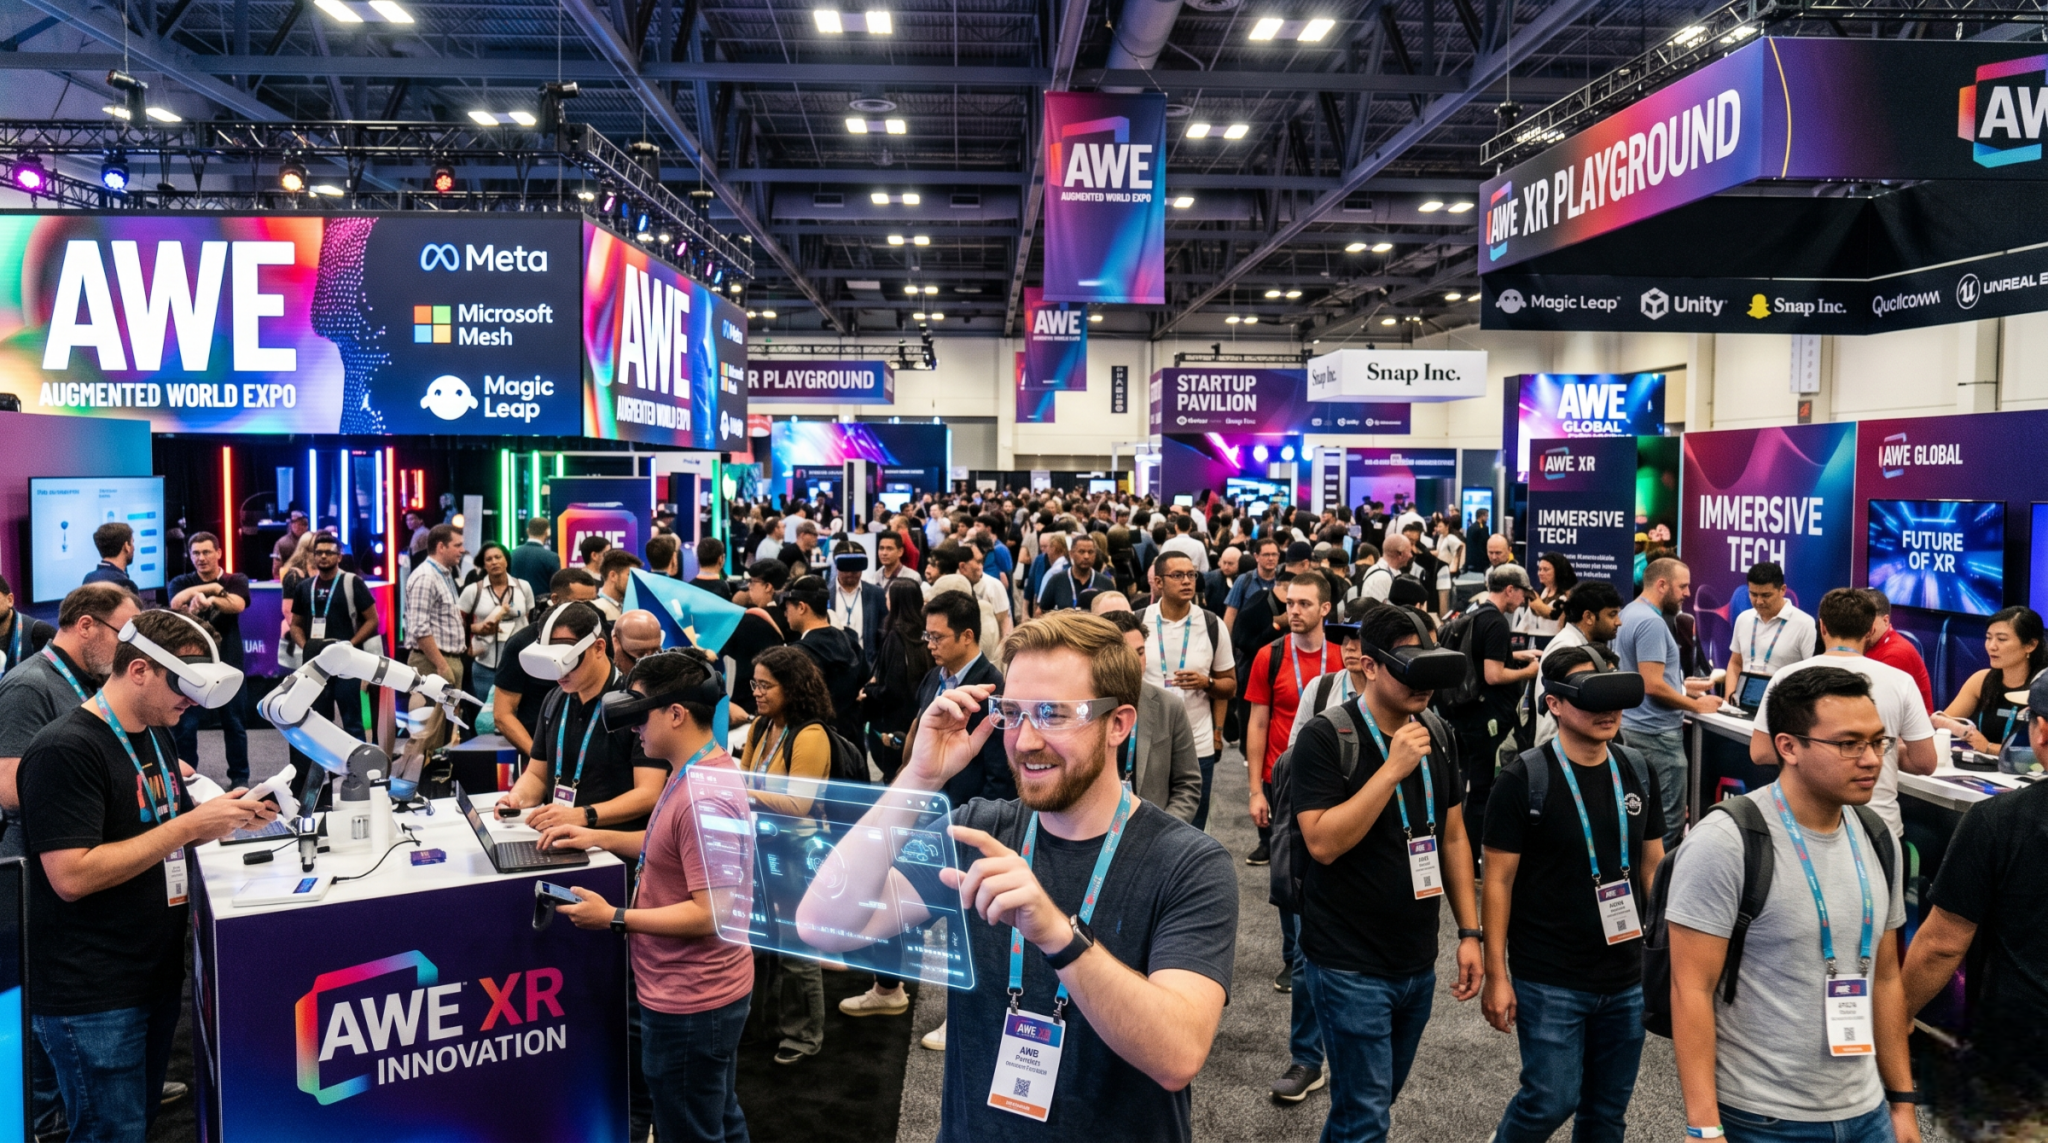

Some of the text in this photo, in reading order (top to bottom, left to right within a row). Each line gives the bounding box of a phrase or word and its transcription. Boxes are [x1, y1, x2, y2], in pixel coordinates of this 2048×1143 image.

[1978, 86, 2048, 139] AW
[1063, 142, 1153, 190] AWE
[1490, 88, 1741, 244] AWE XR PLAYGROUND
[1132, 193, 1152, 203] EXPO
[465, 243, 548, 272] Meta
[1983, 274, 2037, 294] UNREAL
[42, 240, 297, 371] AWE
[458, 303, 553, 324] Microsoft
[1531, 294, 1577, 312] Magic
[1674, 296, 1724, 316] Unity
[1774, 297, 1847, 317] Snap Inc.
[617, 263, 690, 400] AWE
[1033, 310, 1081, 335] AWE
[458, 326, 513, 346] Mesh
[763, 370, 875, 389] PLAYGROUND
[1177, 374, 1257, 392] STARTUP
[1312, 366, 1336, 388] Snap Inc.
[1367, 362, 1461, 386] Snap Inc.
[38, 382, 296, 408] AUGMENTED WORLD EXPO
[484, 375, 554, 401] Magic
[484, 397, 541, 423] Leap
[1177, 393, 1257, 412] PAVILION
[1556, 383, 1628, 420] AWE
[1562, 421, 1622, 433] GLOBAL
[1545, 455, 1596, 472] AWE XR
[1883, 444, 1963, 466] AWE GLOBAL
[1538, 509, 1624, 528] IMMERSIVE
[1699, 494, 1823, 536] IMMERSIVE
[1538, 527, 1577, 545] TECH
[1902, 530, 1964, 552] FUTURE
[1727, 536, 1786, 575] TECH
[1908, 551, 1955, 573] OF XR
[478, 967, 566, 1032] XR
[1017, 1023, 1037, 1036] AWE
[378, 1024, 566, 1086] INNOVATION
